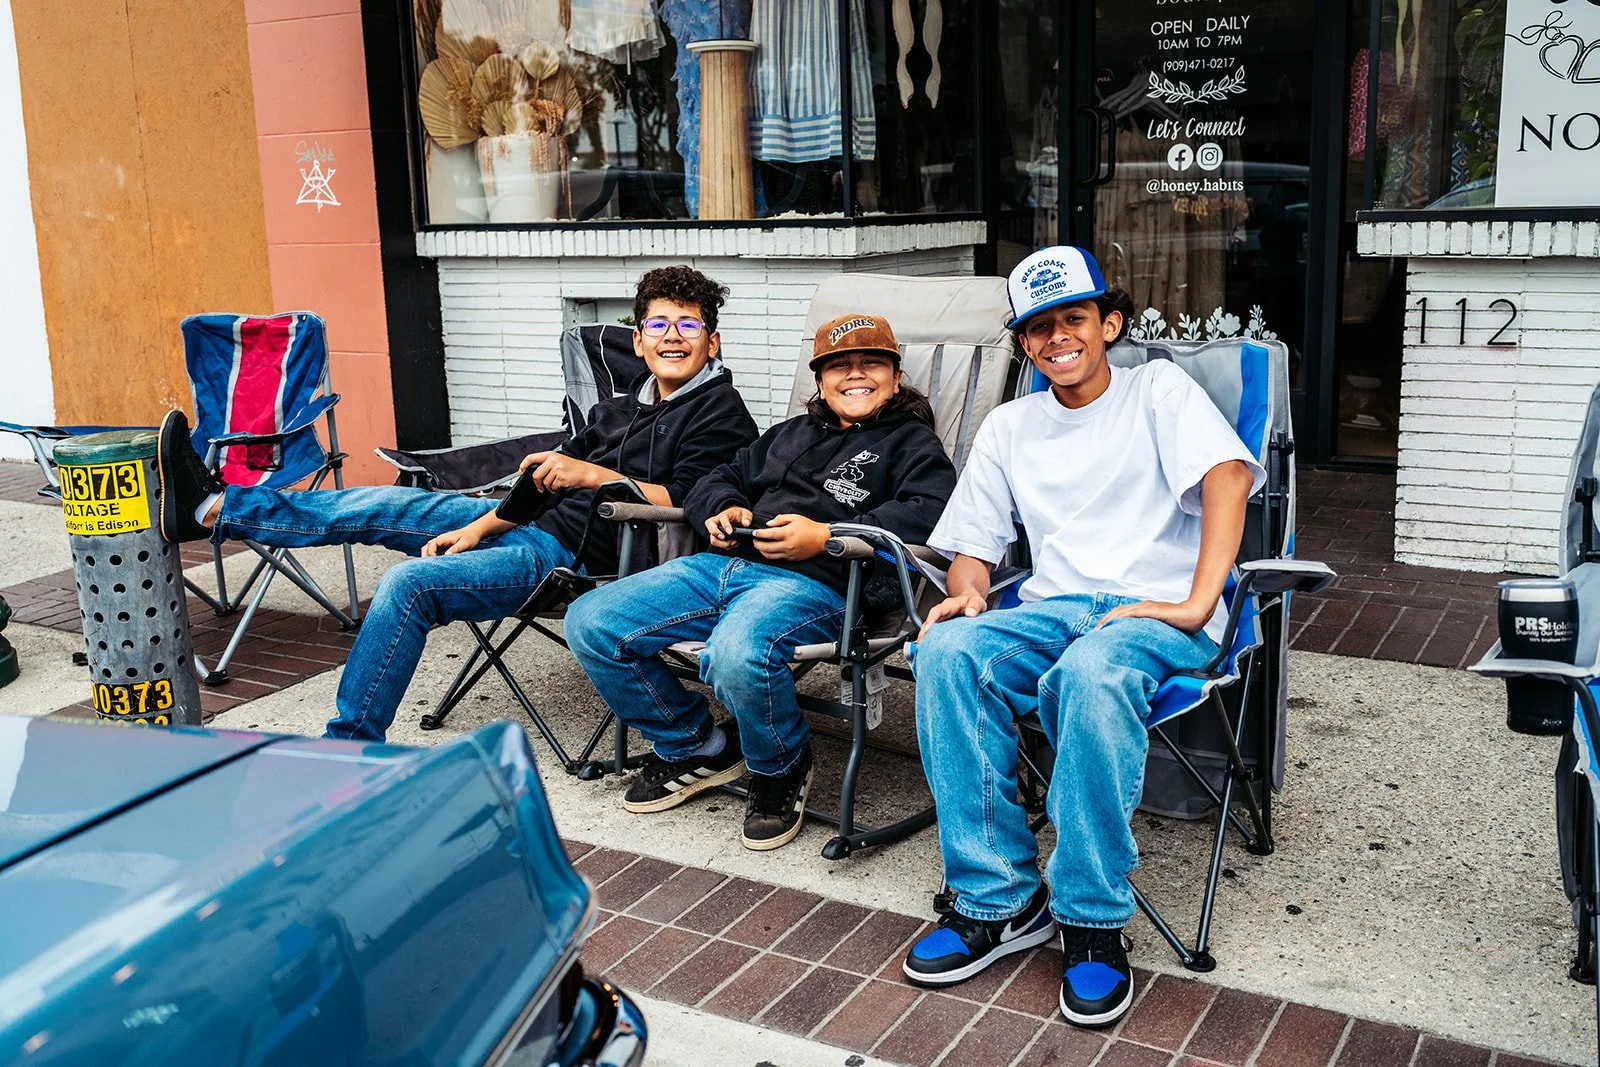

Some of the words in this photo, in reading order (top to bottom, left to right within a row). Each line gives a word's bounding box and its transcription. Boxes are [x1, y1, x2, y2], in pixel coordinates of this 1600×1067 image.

[1150, 19, 1193, 36] OPEN
[1206, 15, 1251, 32] DAILY
[1158, 38, 1189, 50] 10AM
[1195, 36, 1211, 48] TO
[1217, 35, 1243, 47] 7PM
[1162, 57, 1236, 74] (909)471-0217
[1147, 118, 1182, 140] Let's
[1185, 116, 1246, 139] Connect
[1146, 177, 1244, 194] @honey.habits
[1415, 296, 1518, 346] 112
[829, 317, 876, 346] PADRES
[827, 482, 862, 498] CHEVROLET
[97, 519, 139, 531] Edison
[1515, 616, 1549, 631] PRS
